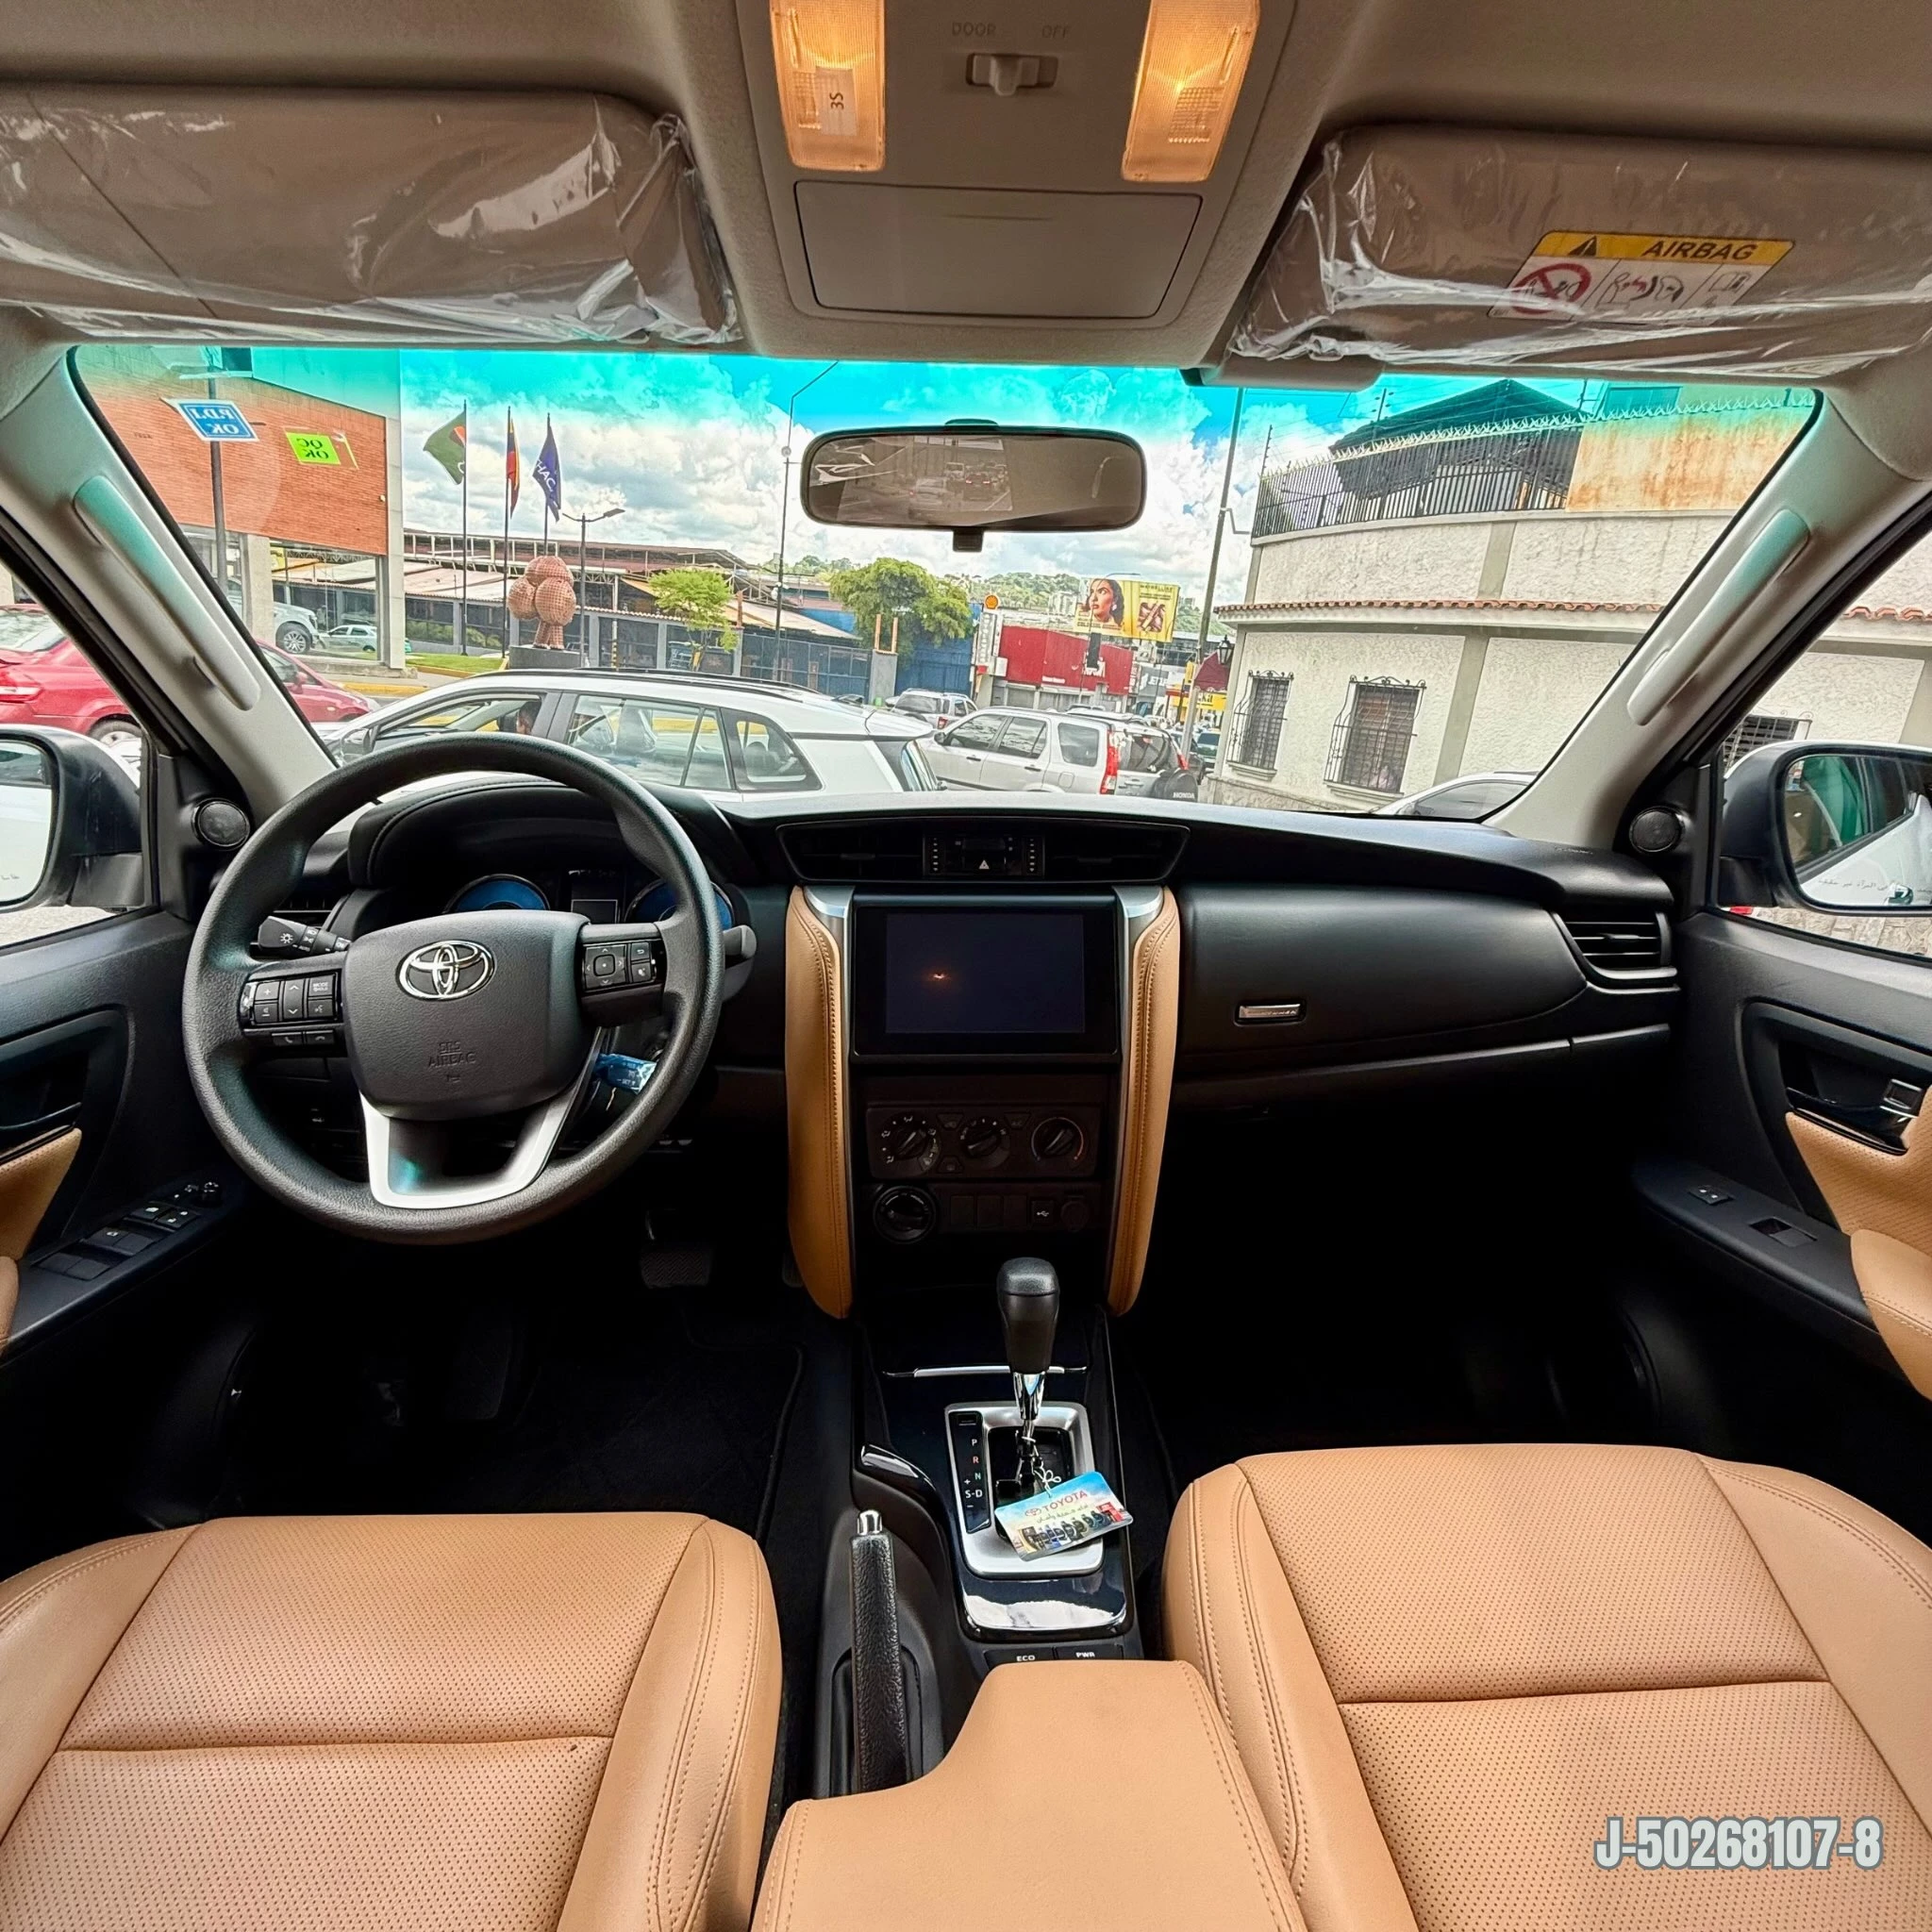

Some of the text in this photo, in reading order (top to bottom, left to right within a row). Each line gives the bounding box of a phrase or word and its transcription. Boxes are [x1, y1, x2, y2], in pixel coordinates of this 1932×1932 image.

[951, 22, 997, 37] DOOR
[1041, 25, 1073, 39] OFF
[828, 92, 844, 110] 3S
[1641, 239, 1758, 261] AIRBAG
[428, 1051, 476, 1069] AIRBAG
[971, 1439, 978, 1447] P
[972, 1456, 979, 1464] R
[974, 1472, 982, 1480] N
[1042, 1490, 1089, 1512] TOYOTA
[1016, 1654, 1036, 1662] ECO
